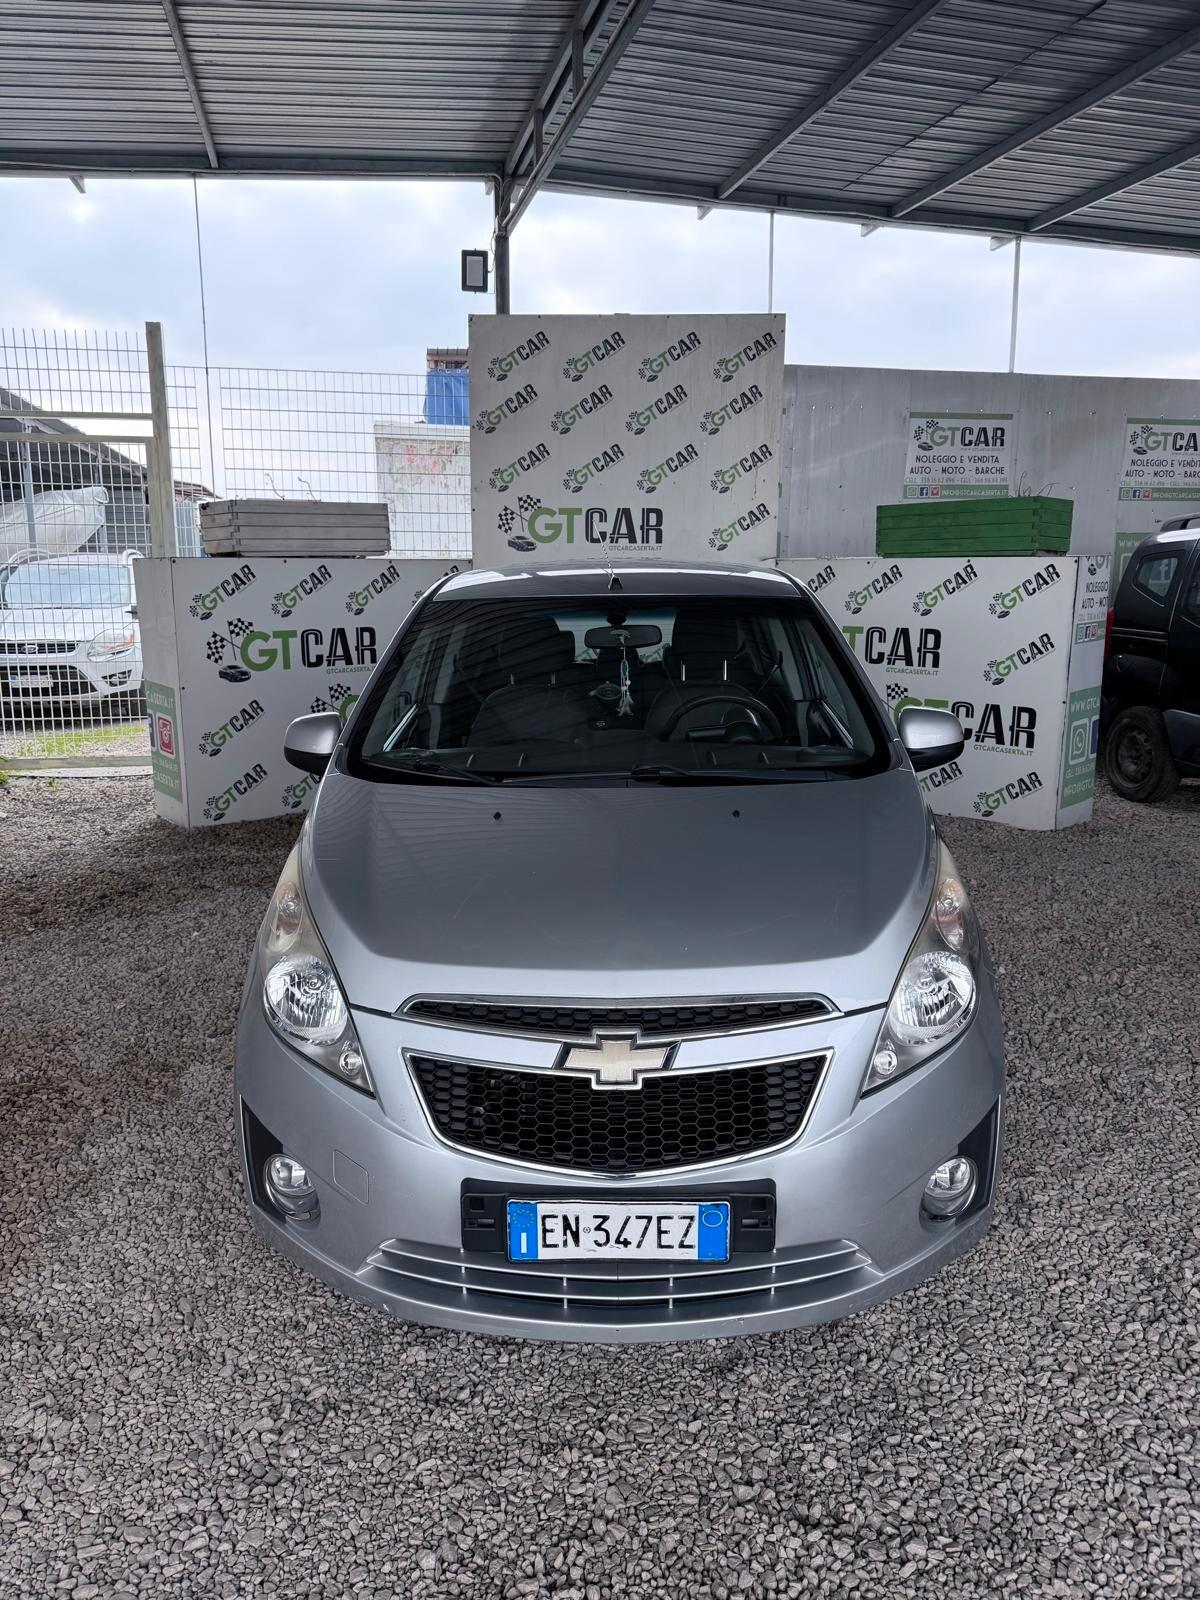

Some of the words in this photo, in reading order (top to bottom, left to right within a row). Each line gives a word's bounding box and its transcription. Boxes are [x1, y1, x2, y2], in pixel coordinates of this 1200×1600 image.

[498, 331, 550, 375] GTCAR
[573, 331, 626, 375] GTCAR
[648, 331, 701, 375] GTCAR
[724, 331, 777, 375] GTCAR
[487, 384, 538, 426] GTCAR
[561, 384, 613, 428] GTCAR
[636, 384, 688, 428] GTCAR
[710, 384, 764, 428] GTCAR
[929, 426, 1005, 447] GTCAR
[1144, 431, 1199, 452] GTCA
[499, 443, 551, 485] GTCAR
[573, 443, 625, 486] GTCAR
[646, 443, 699, 486] GTCAR
[720, 443, 773, 487] GTCAR
[909, 466, 932, 475] AUTO
[941, 466, 966, 475] MOTO
[975, 466, 1005, 475] BARCHE
[915, 454, 957, 464] NOLEGGIO
[959, 455, 965, 464] E
[967, 455, 1000, 464] VENDITA
[1124, 469, 1145, 478] AUTO
[1153, 469, 1176, 478] MOTO
[1130, 458, 1169, 468] NOLEGGIO
[1170, 459, 1175, 467] E
[527, 507, 664, 545] GTCAR
[719, 503, 771, 544] GTCAR
[200, 564, 257, 611] GTCAR
[280, 564, 332, 610] GTCAR
[353, 564, 401, 607] GTCAR
[807, 565, 837, 593] CAR
[853, 564, 903, 609] GTCAR
[922, 563, 978, 610] GTCAR
[1000, 563, 1061, 611] GTCAR
[1085, 580, 1109, 593] NOLEGGIO
[1081, 597, 1095, 609] AUTO
[1099, 597, 1109, 607] MOT
[240, 626, 377, 671] GTCAR
[841, 626, 942, 669] TCAR
[994, 633, 1056, 679] GTCAR
[885, 667, 939, 676] GTCARCASERTA.IT
[210, 699, 265, 749] GTCAR
[973, 744, 1034, 757] GTCARCASERTA.IT
[214, 763, 268, 813] GTCAR
[919, 761, 963, 792] TCAR
[984, 771, 1043, 811] GTCAR
[540, 1214, 580, 1248] EN
[592, 1214, 696, 1249] 347EZ
